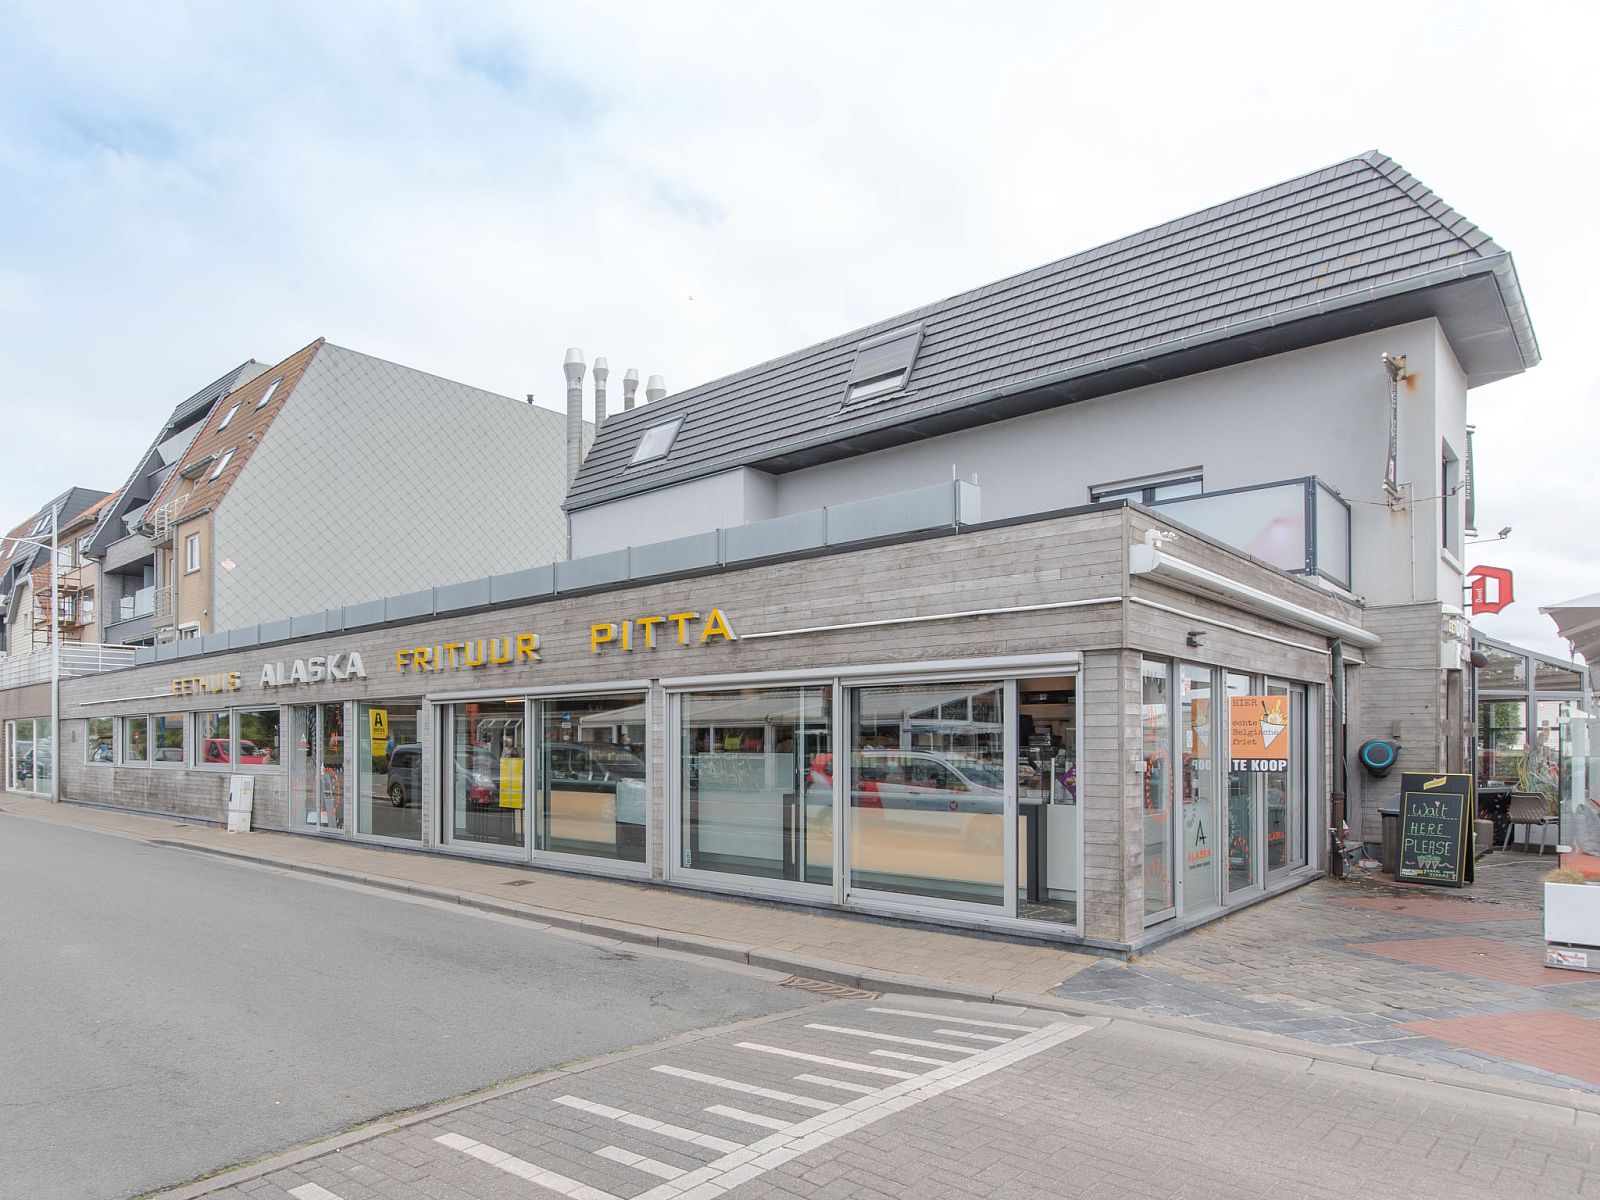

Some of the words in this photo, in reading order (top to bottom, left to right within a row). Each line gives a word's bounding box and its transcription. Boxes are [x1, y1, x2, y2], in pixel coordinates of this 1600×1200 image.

[172, 671, 241, 697] EETHUIS
[260, 651, 367, 690] ALASKA
[396, 633, 542, 674] FRITUUR
[591, 607, 738, 655] PITTA
[1232, 698, 1258, 707] HIER
[374, 712, 384, 727] A
[1232, 738, 1258, 746] friet
[1232, 759, 1248, 771] TE
[1251, 759, 1287, 771] KOOP
[1412, 801, 1448, 817] Wait
[1410, 822, 1444, 835] HERE
[1404, 838, 1453, 856] PLEASE
